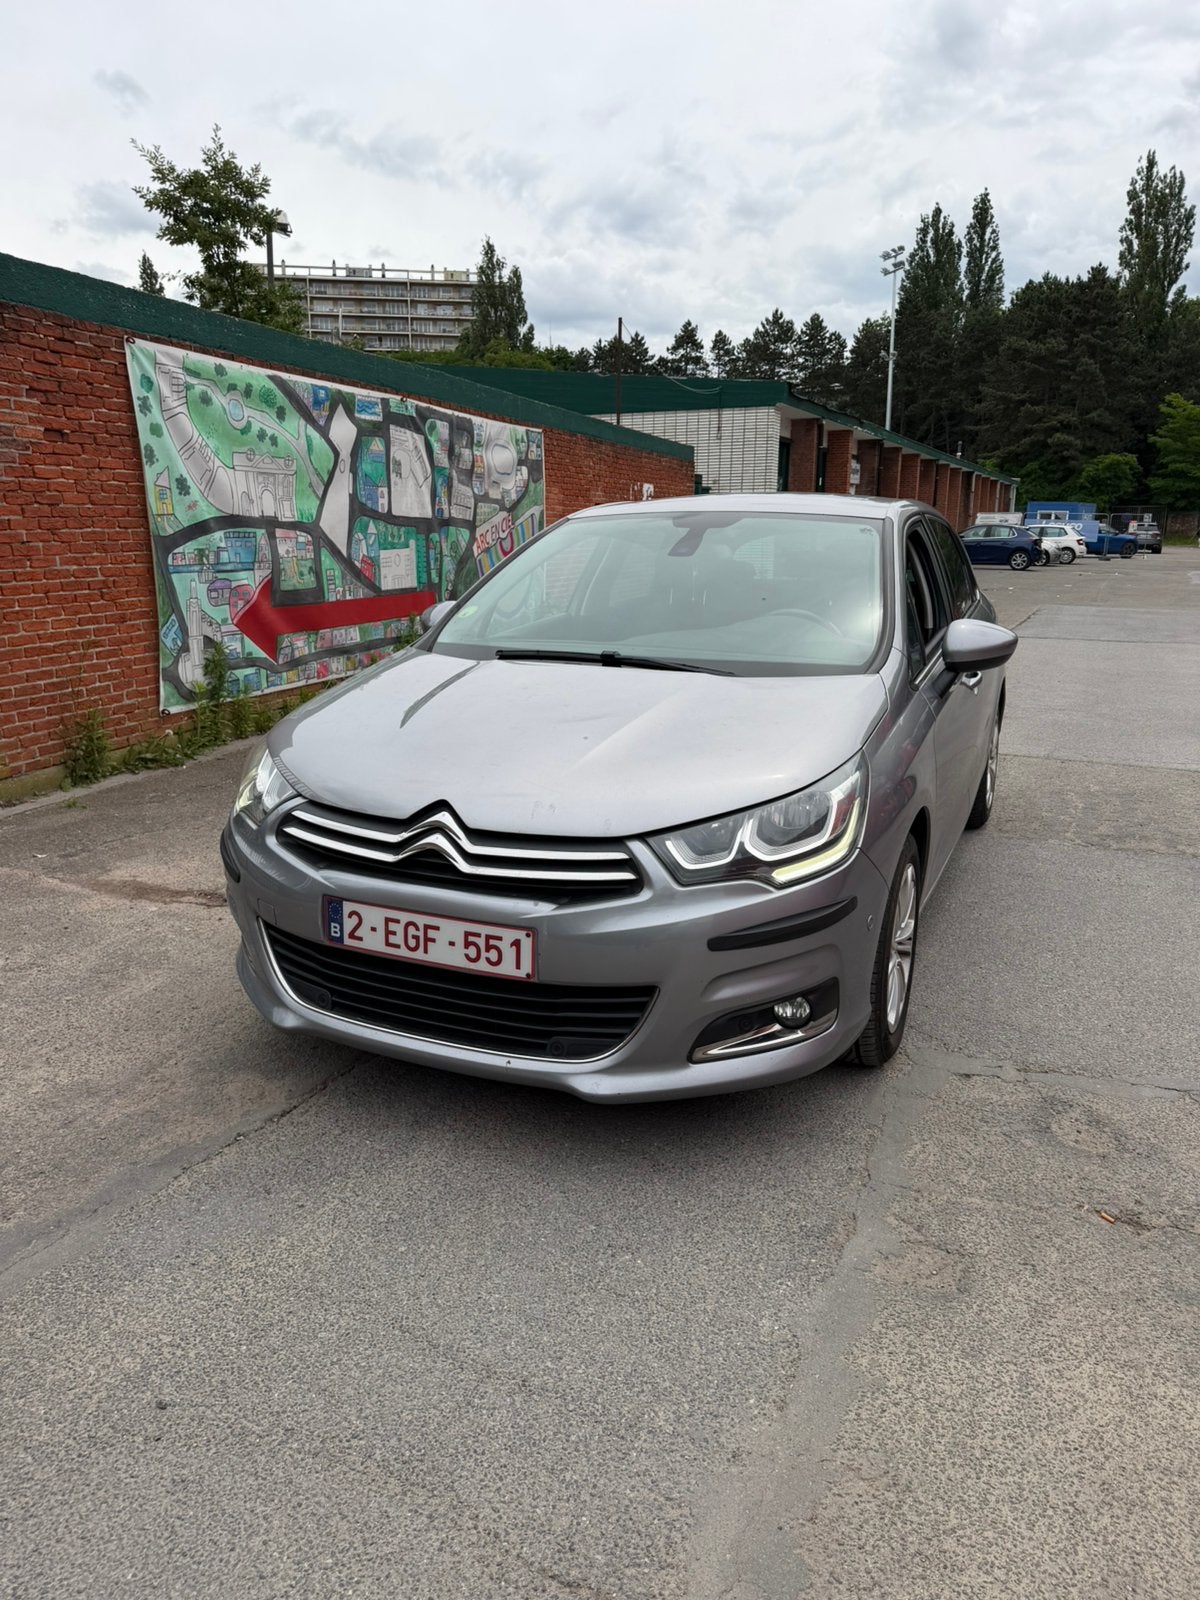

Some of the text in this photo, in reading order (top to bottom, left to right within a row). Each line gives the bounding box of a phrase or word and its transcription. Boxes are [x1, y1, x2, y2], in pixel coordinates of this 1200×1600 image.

[475, 529, 490, 554] ARC
[490, 521, 500, 543] EN
[331, 922, 341, 938] B
[347, 910, 522, 970] 2-EGF-551
